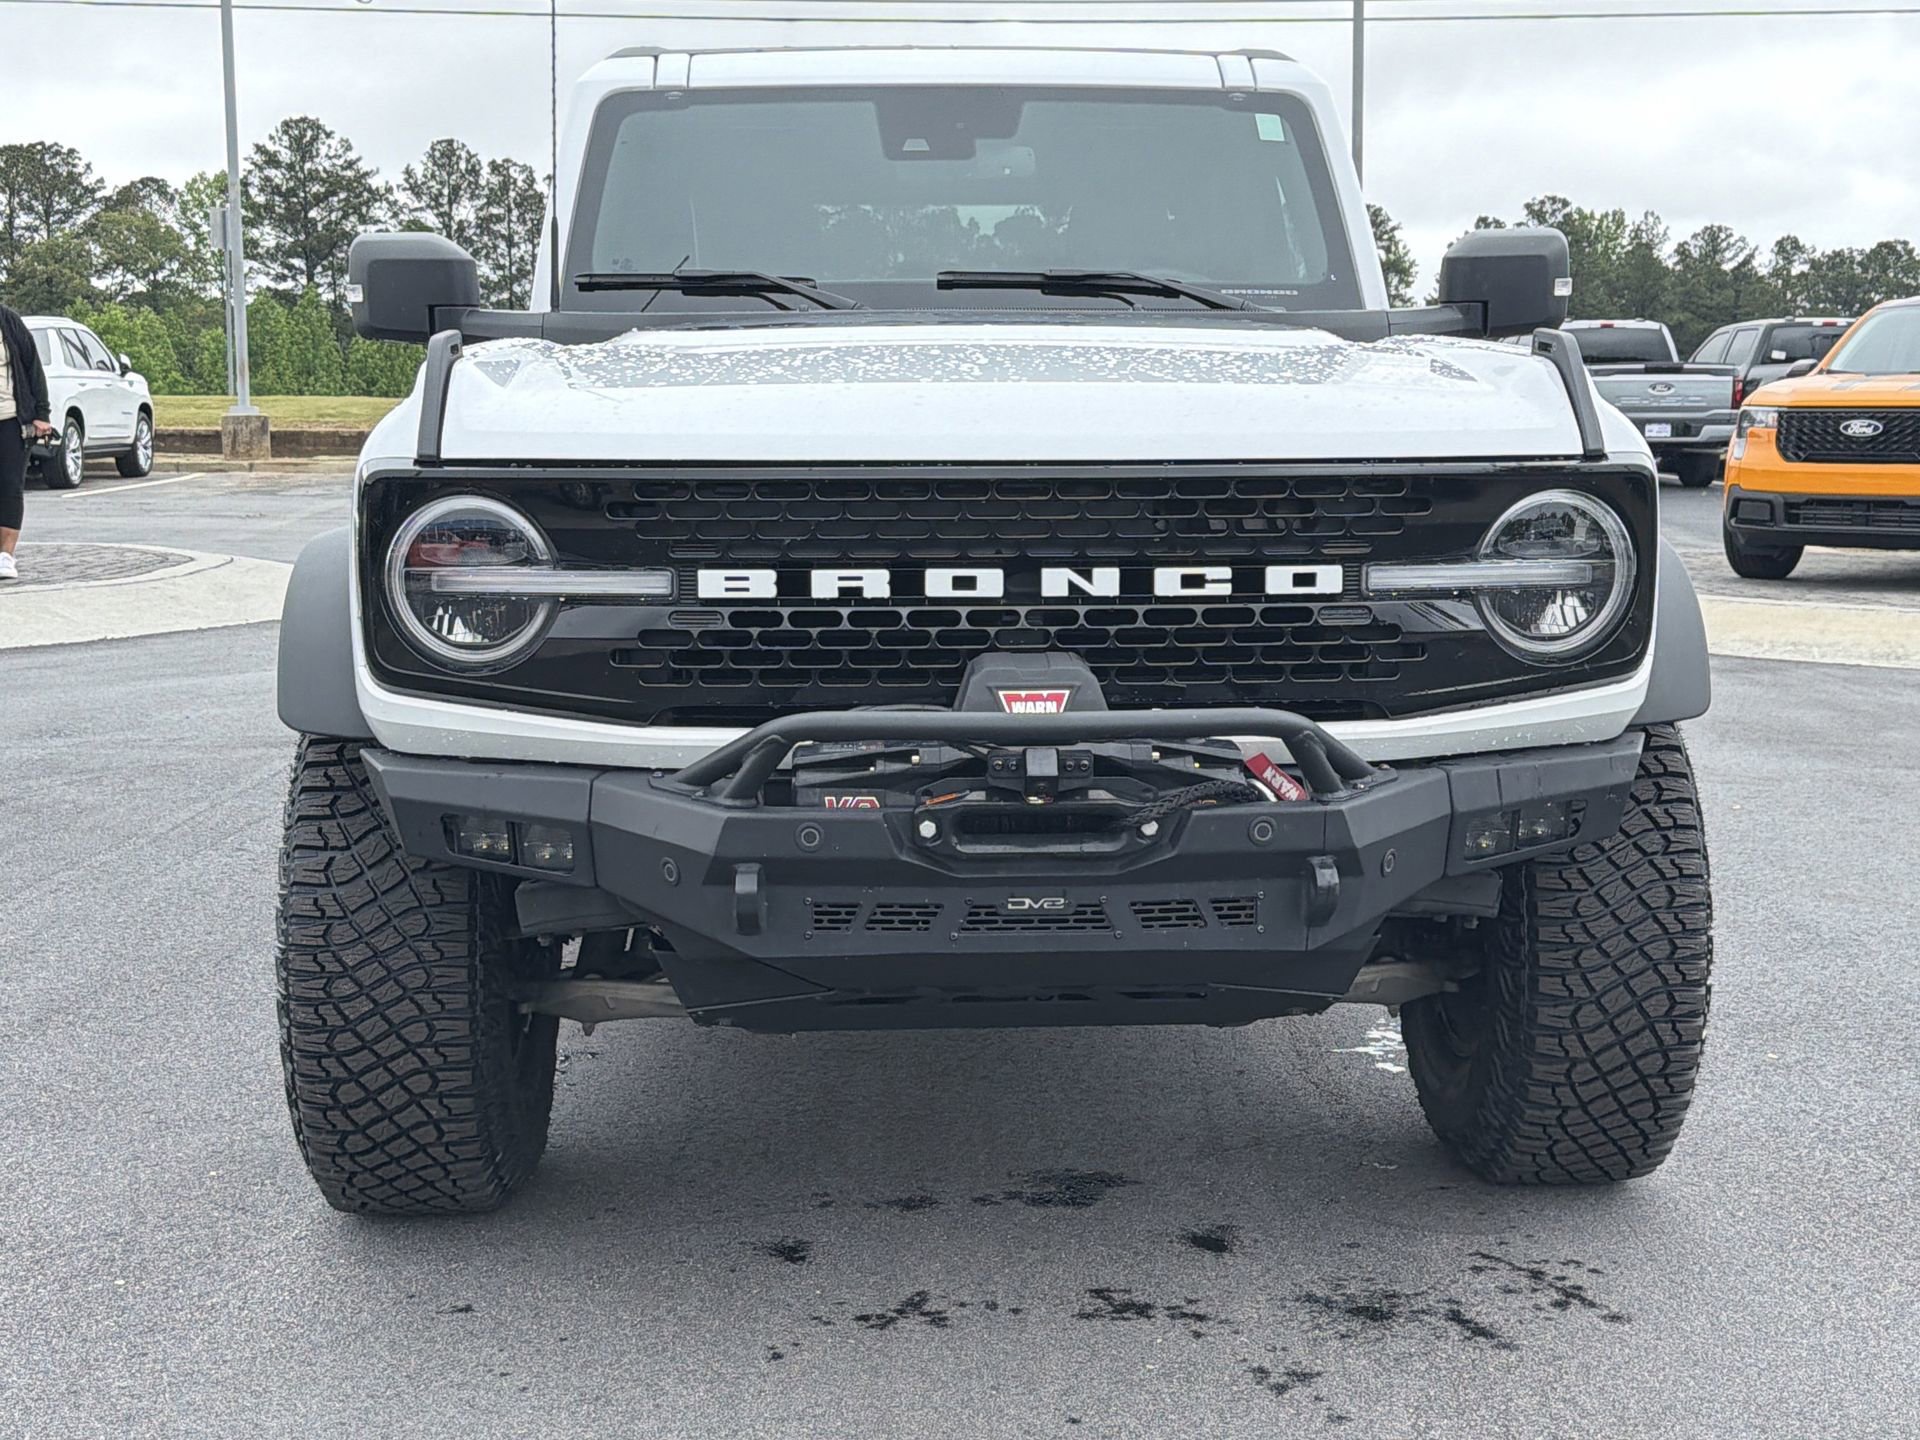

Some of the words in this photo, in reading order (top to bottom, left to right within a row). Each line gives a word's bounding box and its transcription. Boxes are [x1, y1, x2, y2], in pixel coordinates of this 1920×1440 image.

[1846, 420, 1876, 434] Ford
[697, 564, 1344, 599] BRONCO
[1011, 701, 1058, 713] WARN
[1263, 766, 1300, 801] WARN
